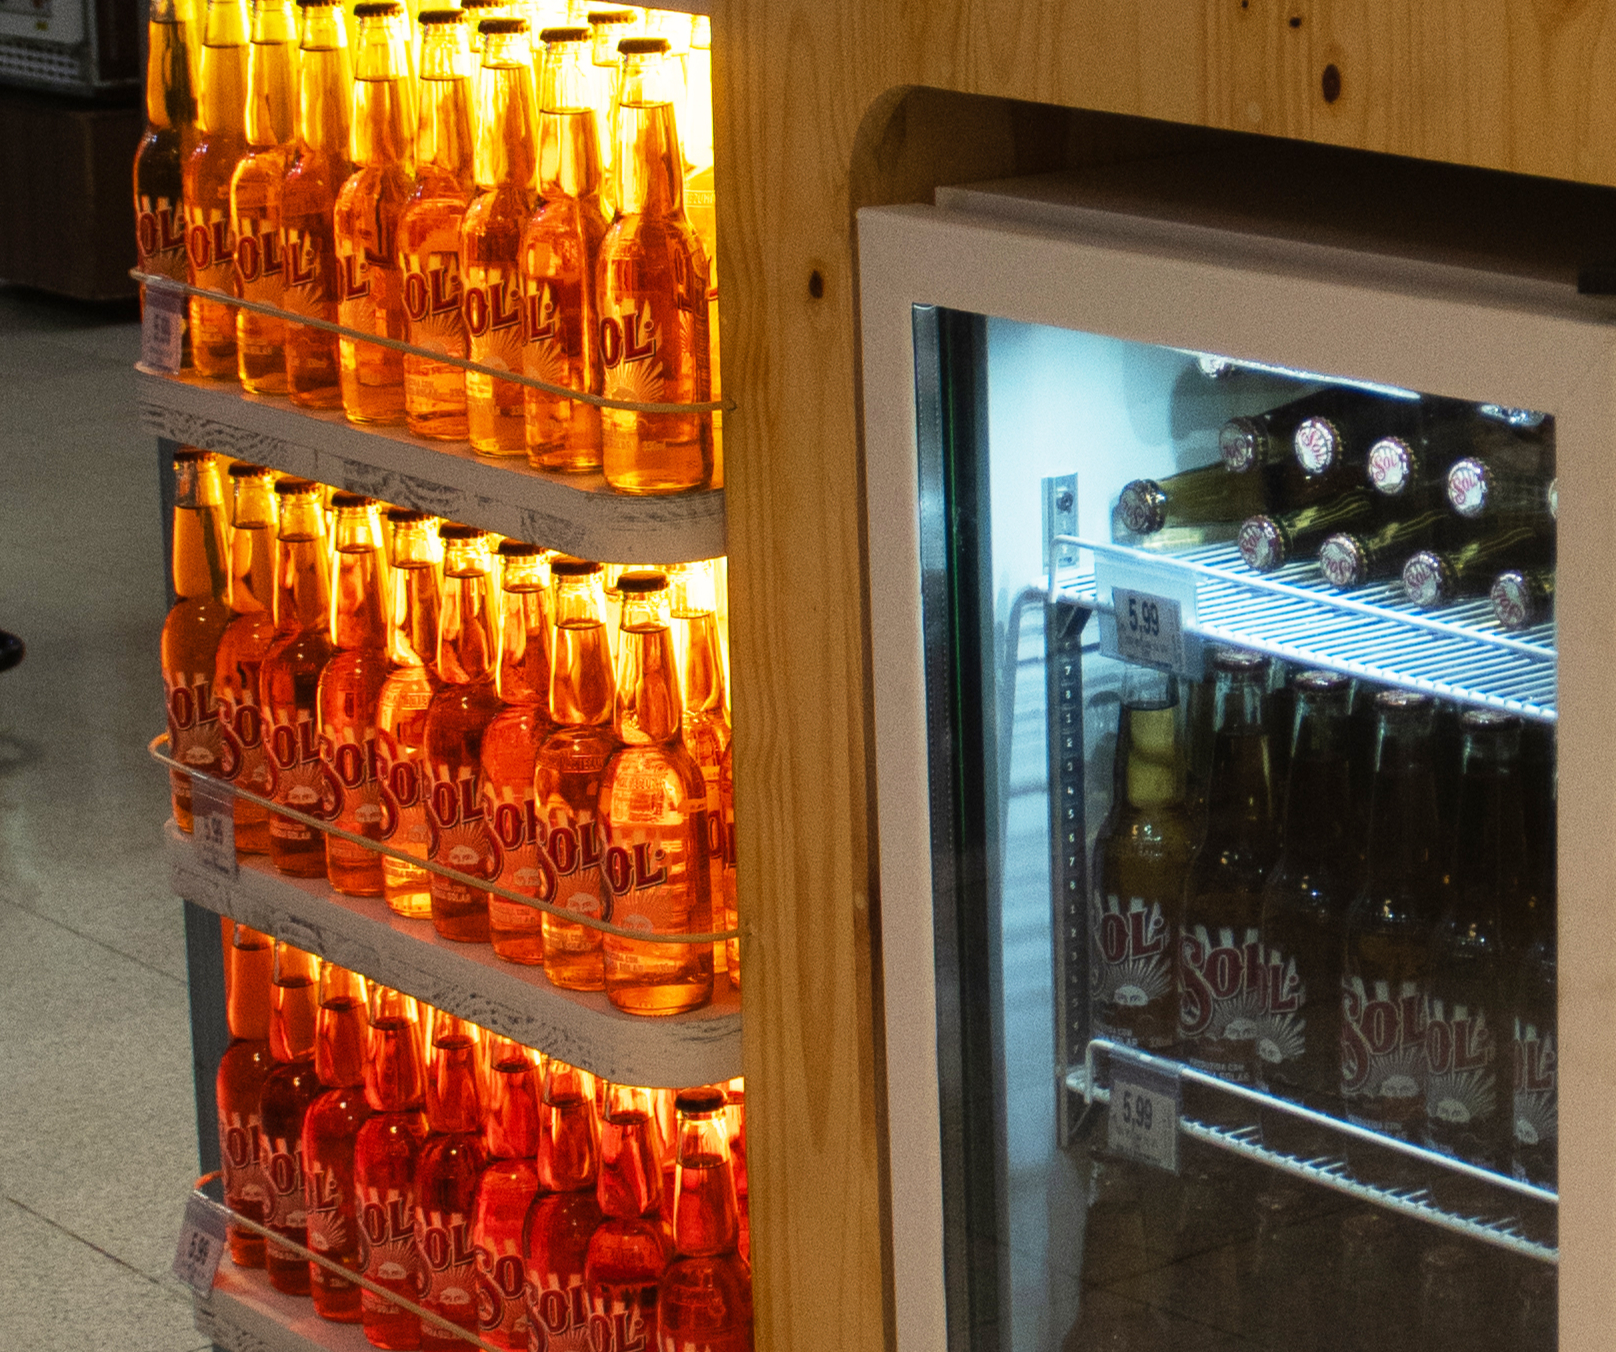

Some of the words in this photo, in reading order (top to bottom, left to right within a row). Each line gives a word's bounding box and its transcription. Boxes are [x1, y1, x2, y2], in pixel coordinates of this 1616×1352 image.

[138, 207, 185, 259] OL
[190, 219, 235, 271] OL
[236, 231, 286, 284] OL
[402, 266, 462, 322] OL
[463, 279, 522, 337] OL
[600, 309, 656, 370] OL
[1373, 454, 1398, 482] SOL
[1452, 474, 1477, 505] SOL
[1128, 592, 1161, 637] 5,99
[168, 681, 222, 731] OL
[1100, 909, 1164, 965] OL
[1426, 1016, 1489, 1076] OL
[1122, 1089, 1153, 1131] 5,99
